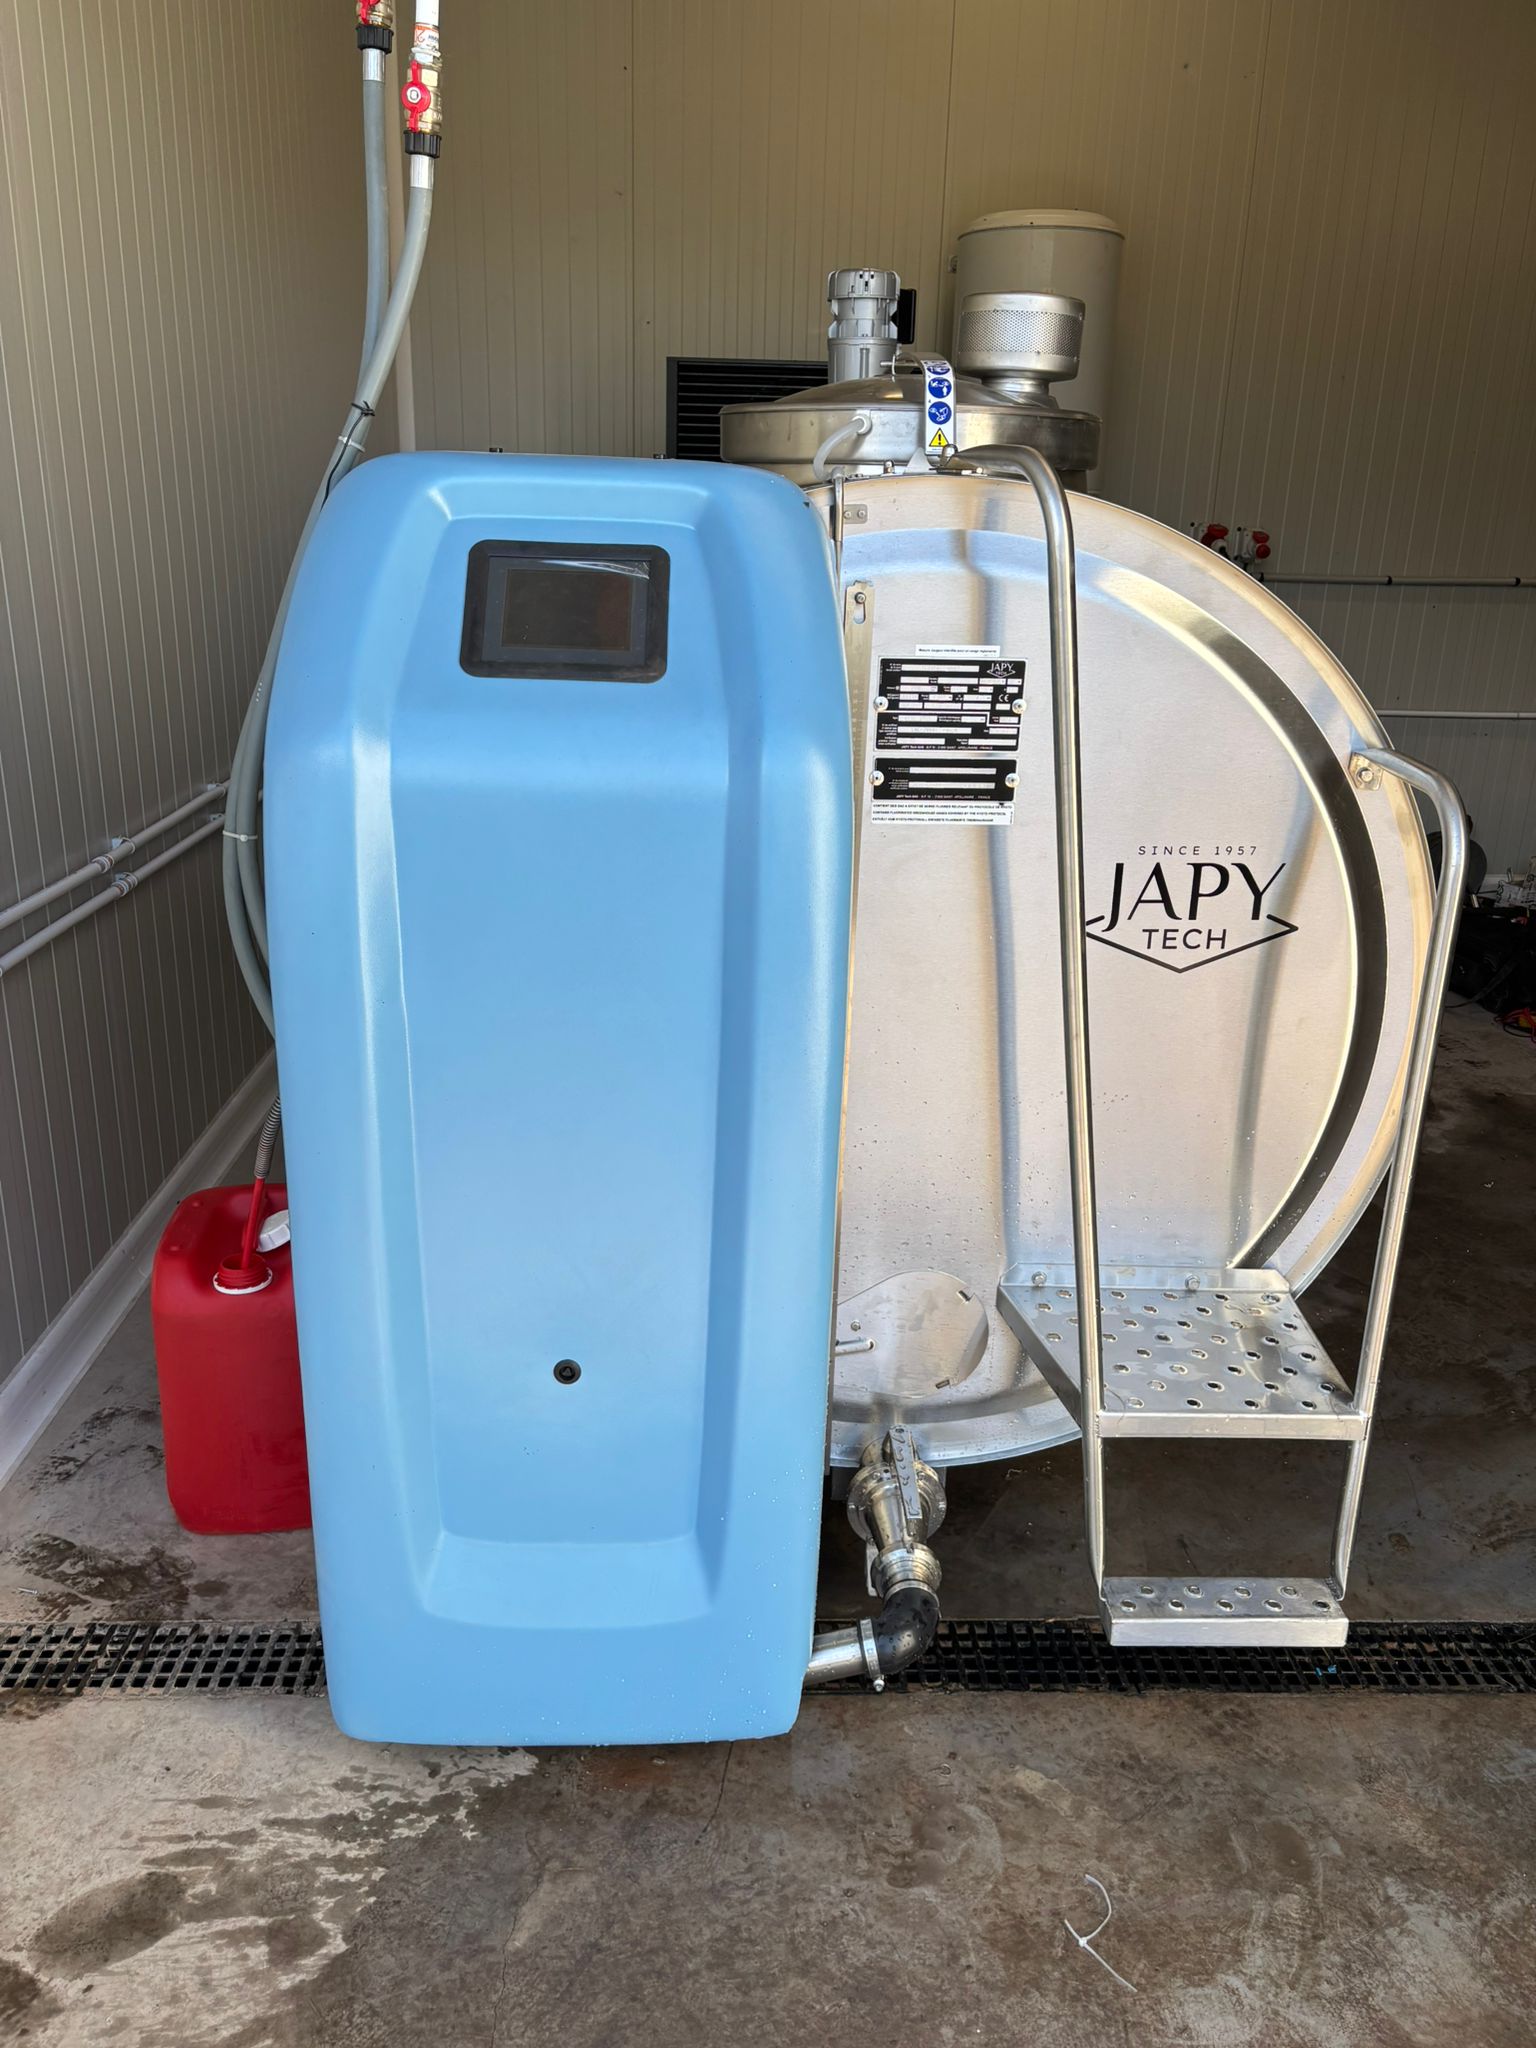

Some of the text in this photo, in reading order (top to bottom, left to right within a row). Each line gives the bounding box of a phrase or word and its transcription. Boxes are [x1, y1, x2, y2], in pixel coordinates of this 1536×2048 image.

[990, 662, 1014, 672] JAPY
[1138, 846, 1257, 856] SINCE 1957
[1101, 862, 1287, 933] JAPY
[1142, 928, 1227, 950] TECH
